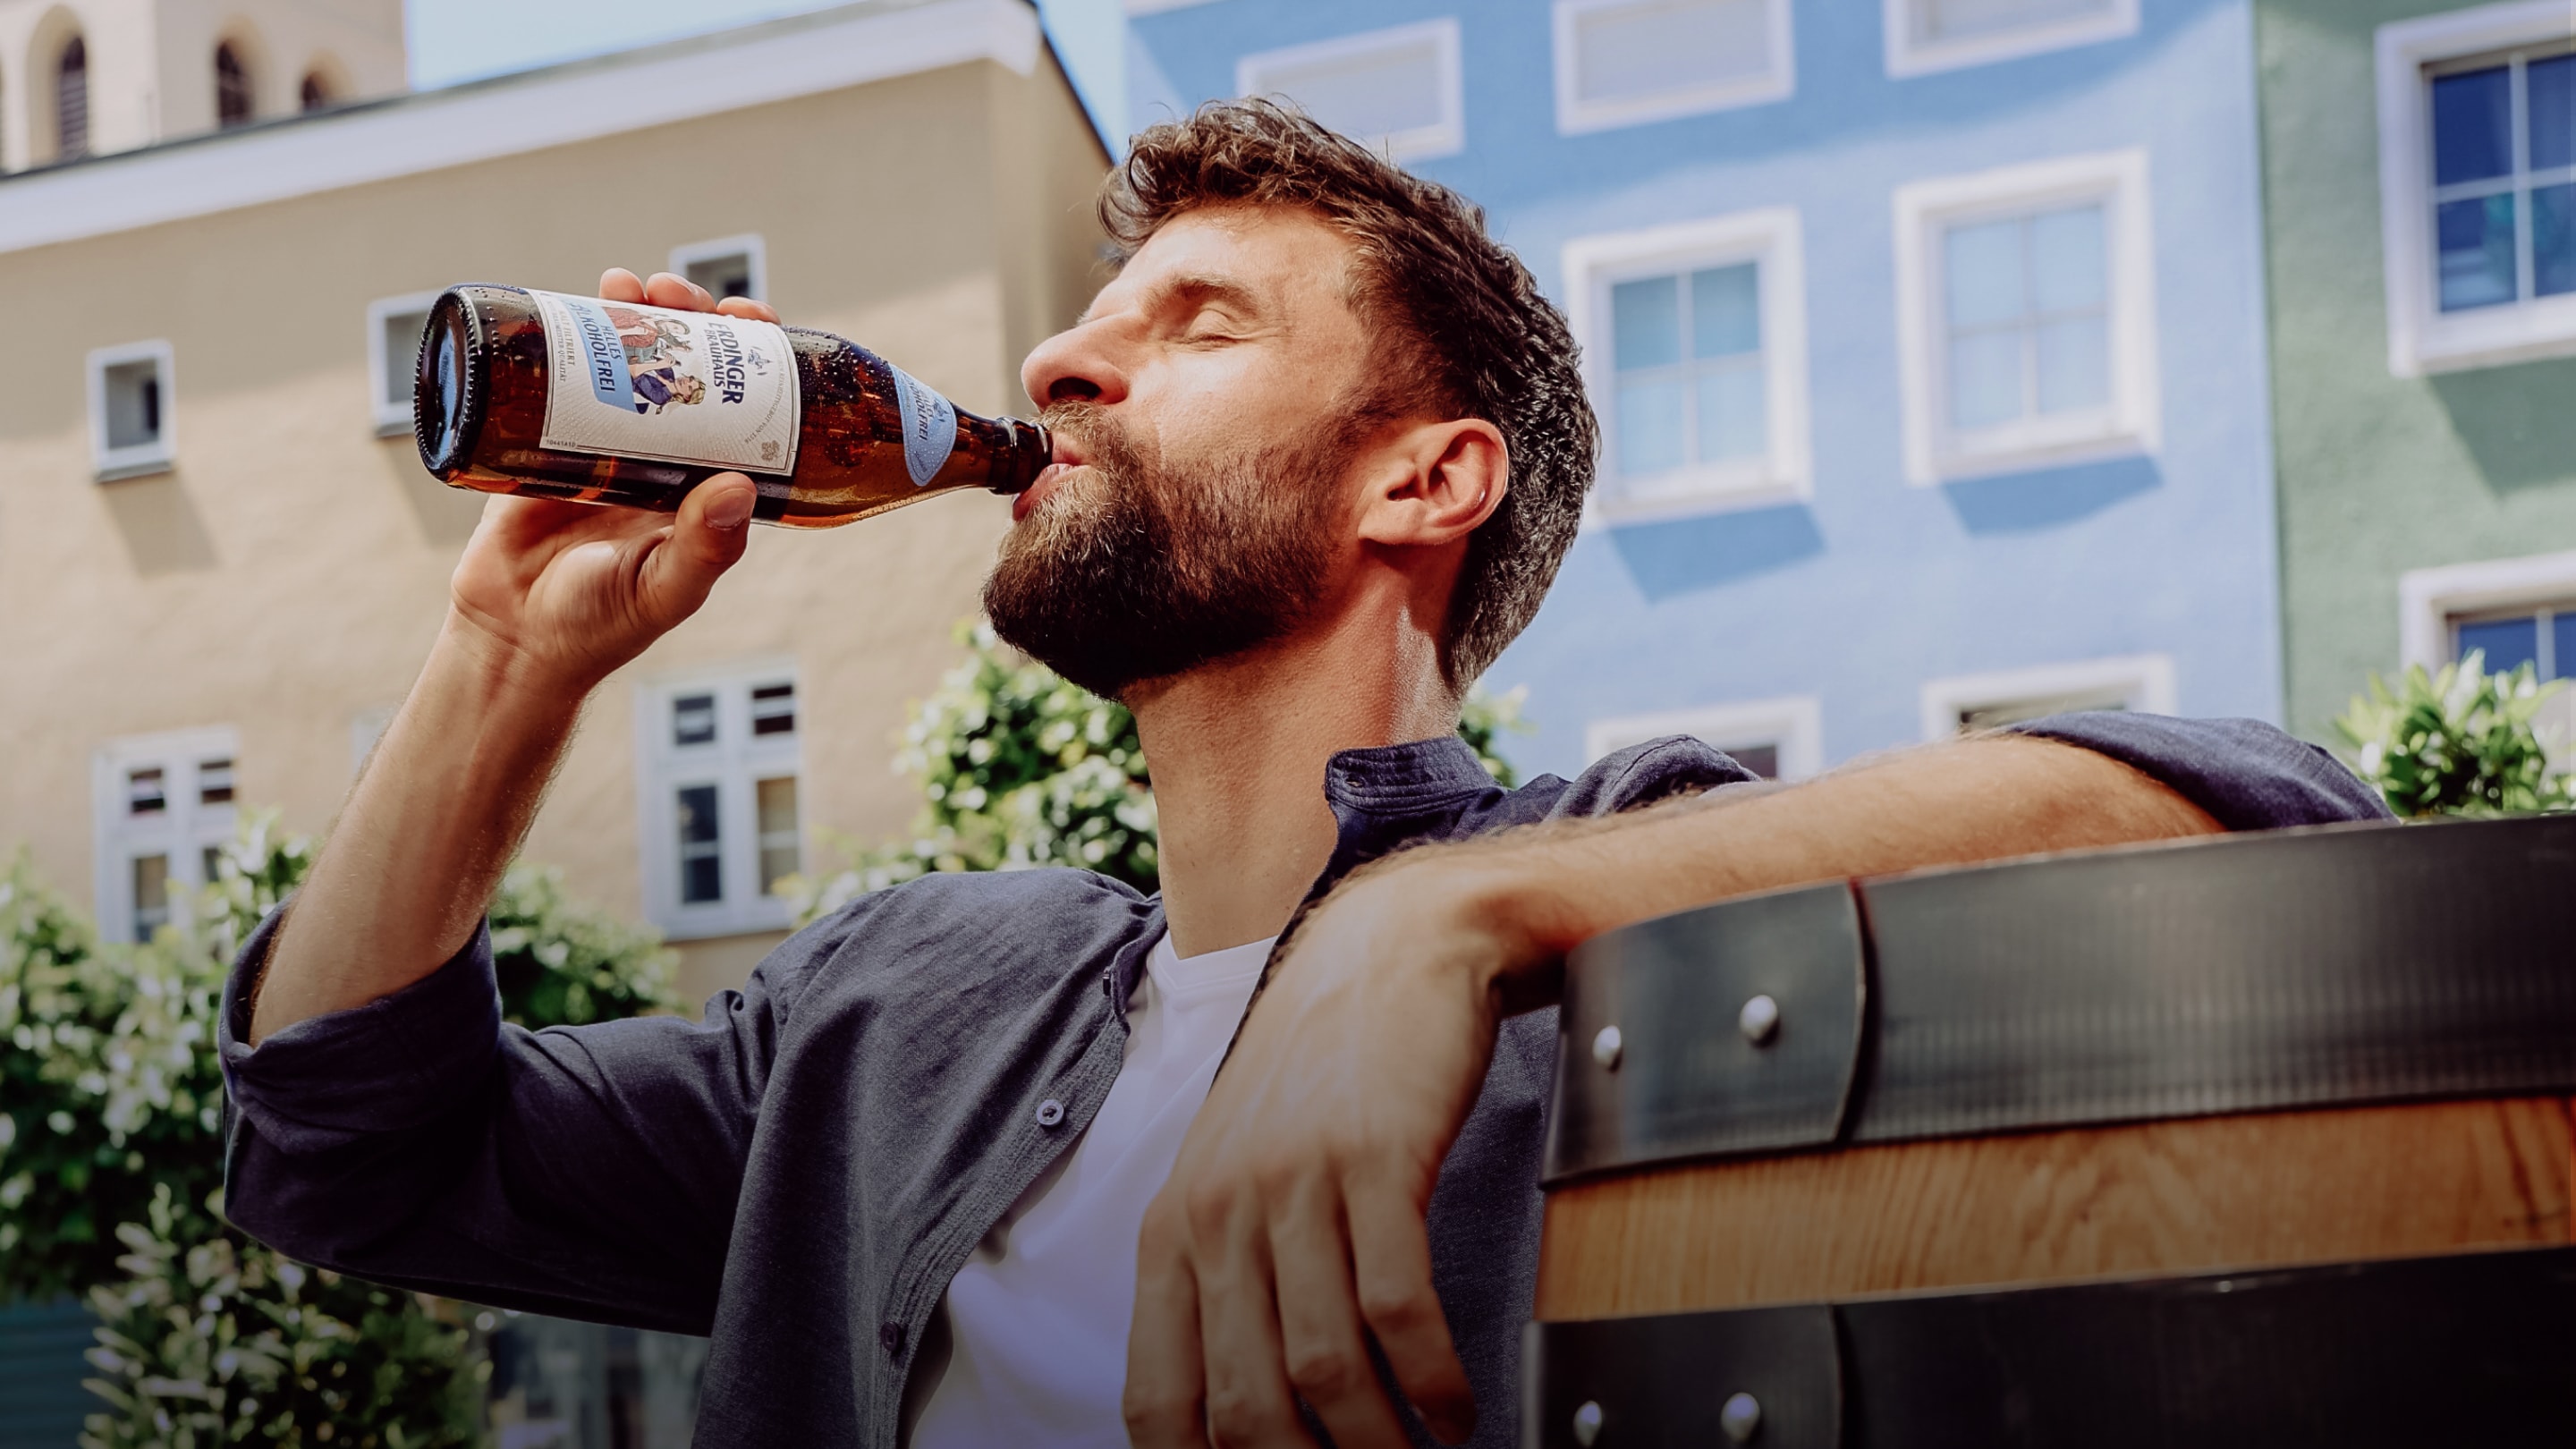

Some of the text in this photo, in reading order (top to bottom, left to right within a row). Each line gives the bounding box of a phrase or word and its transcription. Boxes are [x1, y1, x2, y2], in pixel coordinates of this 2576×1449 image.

[564, 327, 575, 366] FILTRIERT
[568, 302, 616, 392] ALKOHOLFREI
[600, 325, 623, 360] HELLES
[703, 329, 725, 387] BRAUHAUS
[708, 322, 746, 405] ERDINGER
